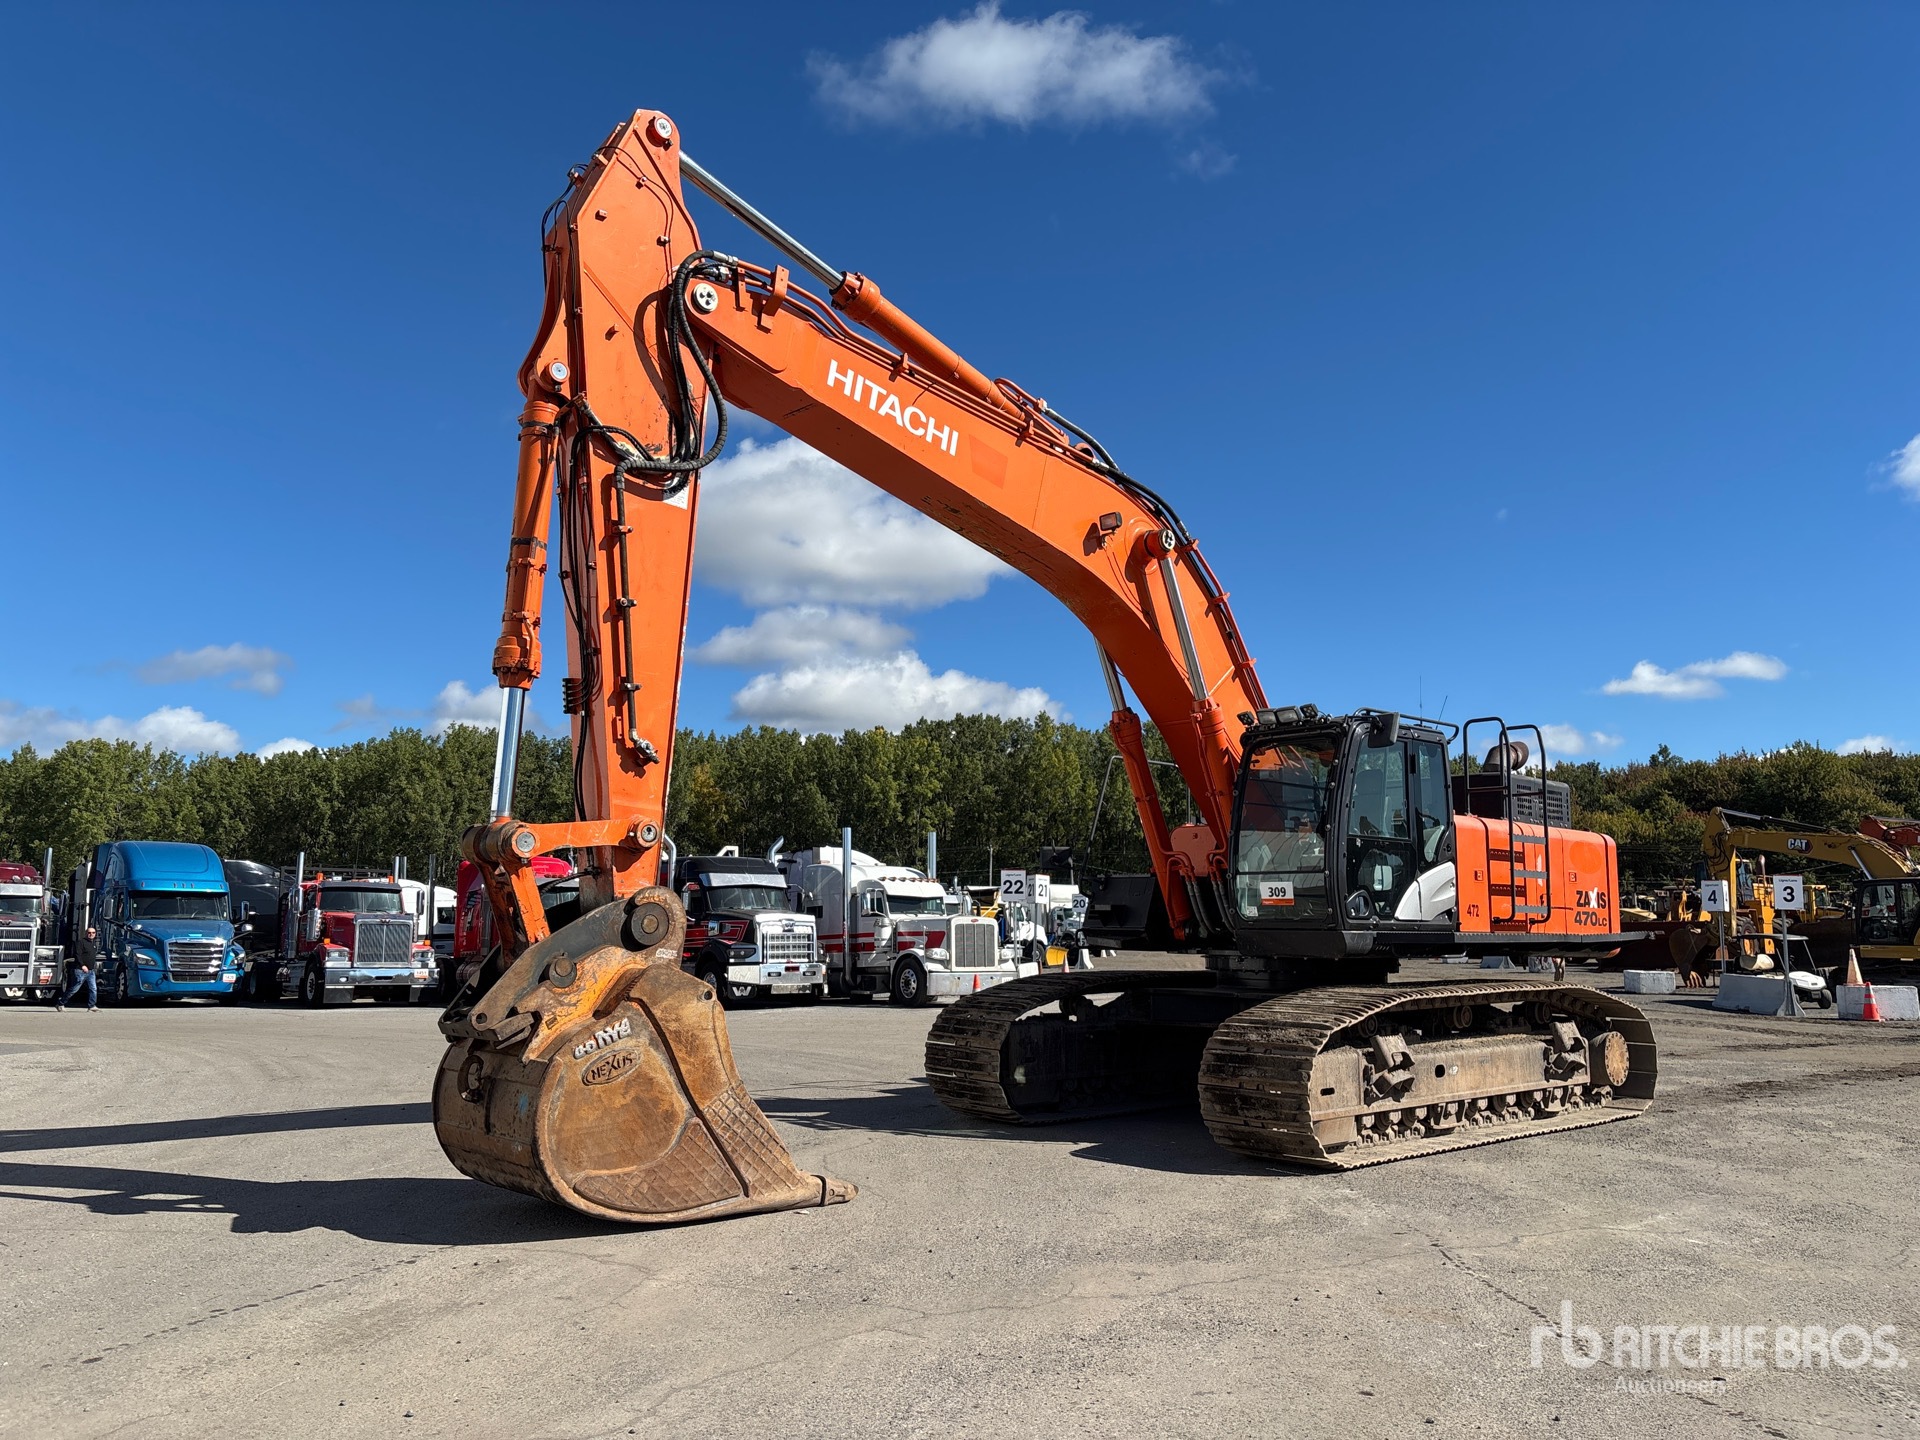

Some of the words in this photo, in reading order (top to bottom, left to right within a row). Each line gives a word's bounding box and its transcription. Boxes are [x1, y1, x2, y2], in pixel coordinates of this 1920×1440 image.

[827, 359, 959, 457] HITACHI
[1787, 838, 1808, 851] CAT
[1003, 880, 1024, 894] 22
[1038, 884, 1048, 897] 21
[1268, 887, 1287, 897] 309
[1782, 886, 1795, 902] 3
[1073, 899, 1085, 908] 20
[1576, 887, 1607, 909] ZAXIS
[1707, 890, 1718, 904] 4
[1466, 904, 1480, 917] 472
[591, 1052, 633, 1080] NEXUS
